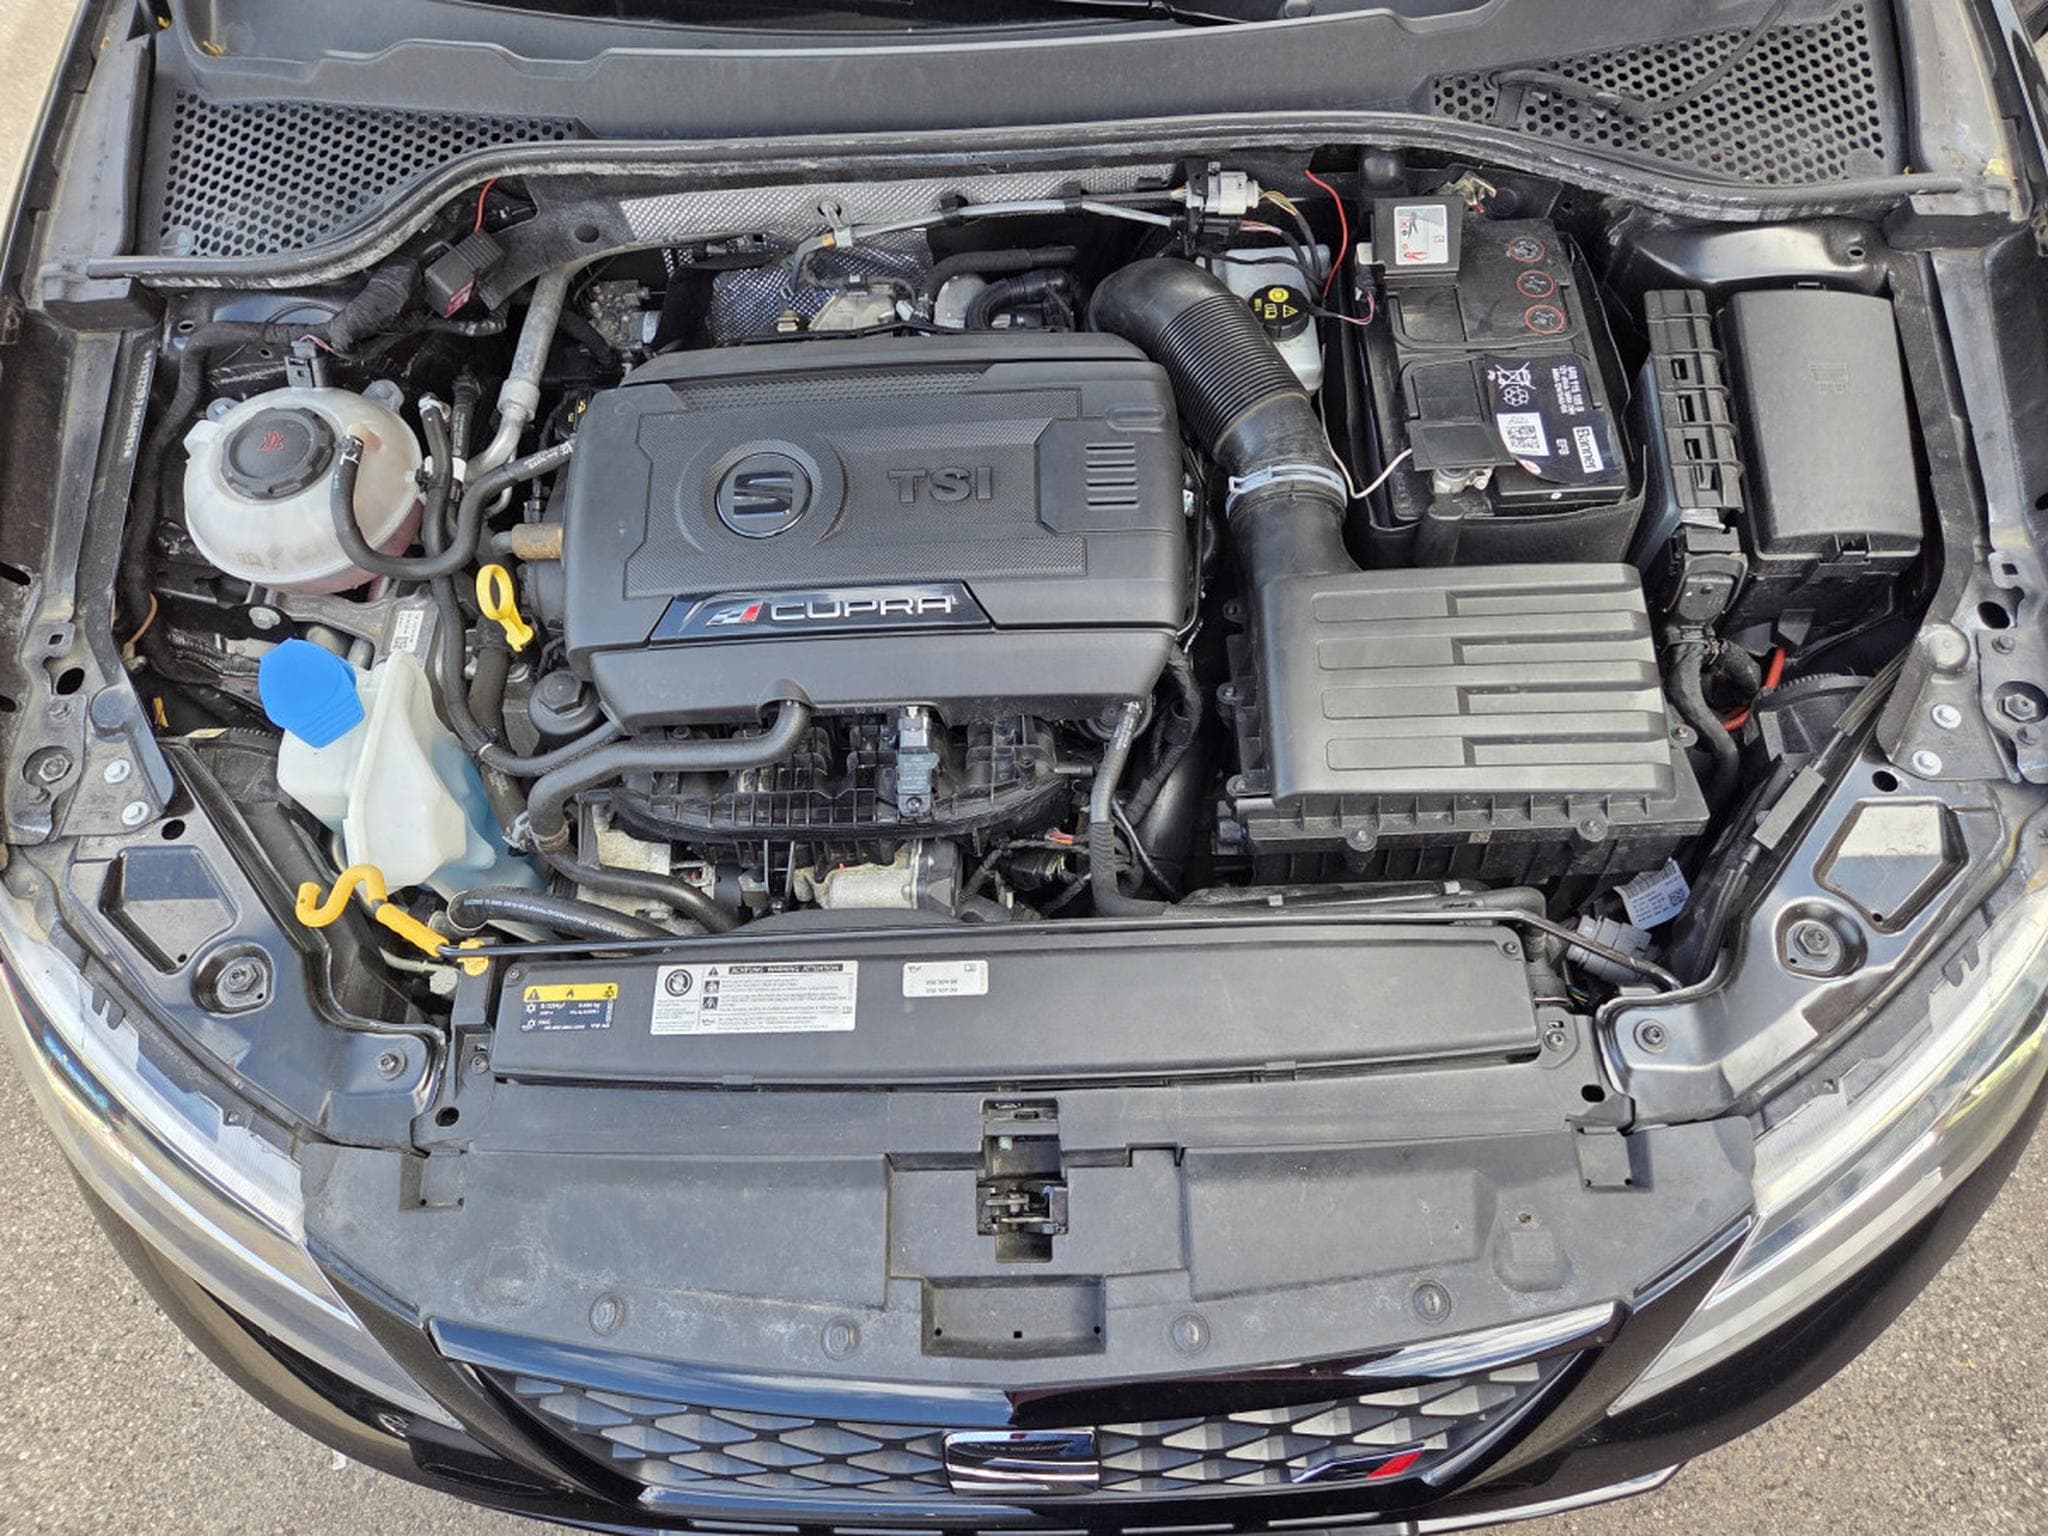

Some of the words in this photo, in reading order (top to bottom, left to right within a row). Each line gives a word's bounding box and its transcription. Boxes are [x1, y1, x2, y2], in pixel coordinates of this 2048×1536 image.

[1576, 428, 1597, 469] Banner
[887, 466, 992, 503] TSI
[770, 595, 952, 621] CUPRA
